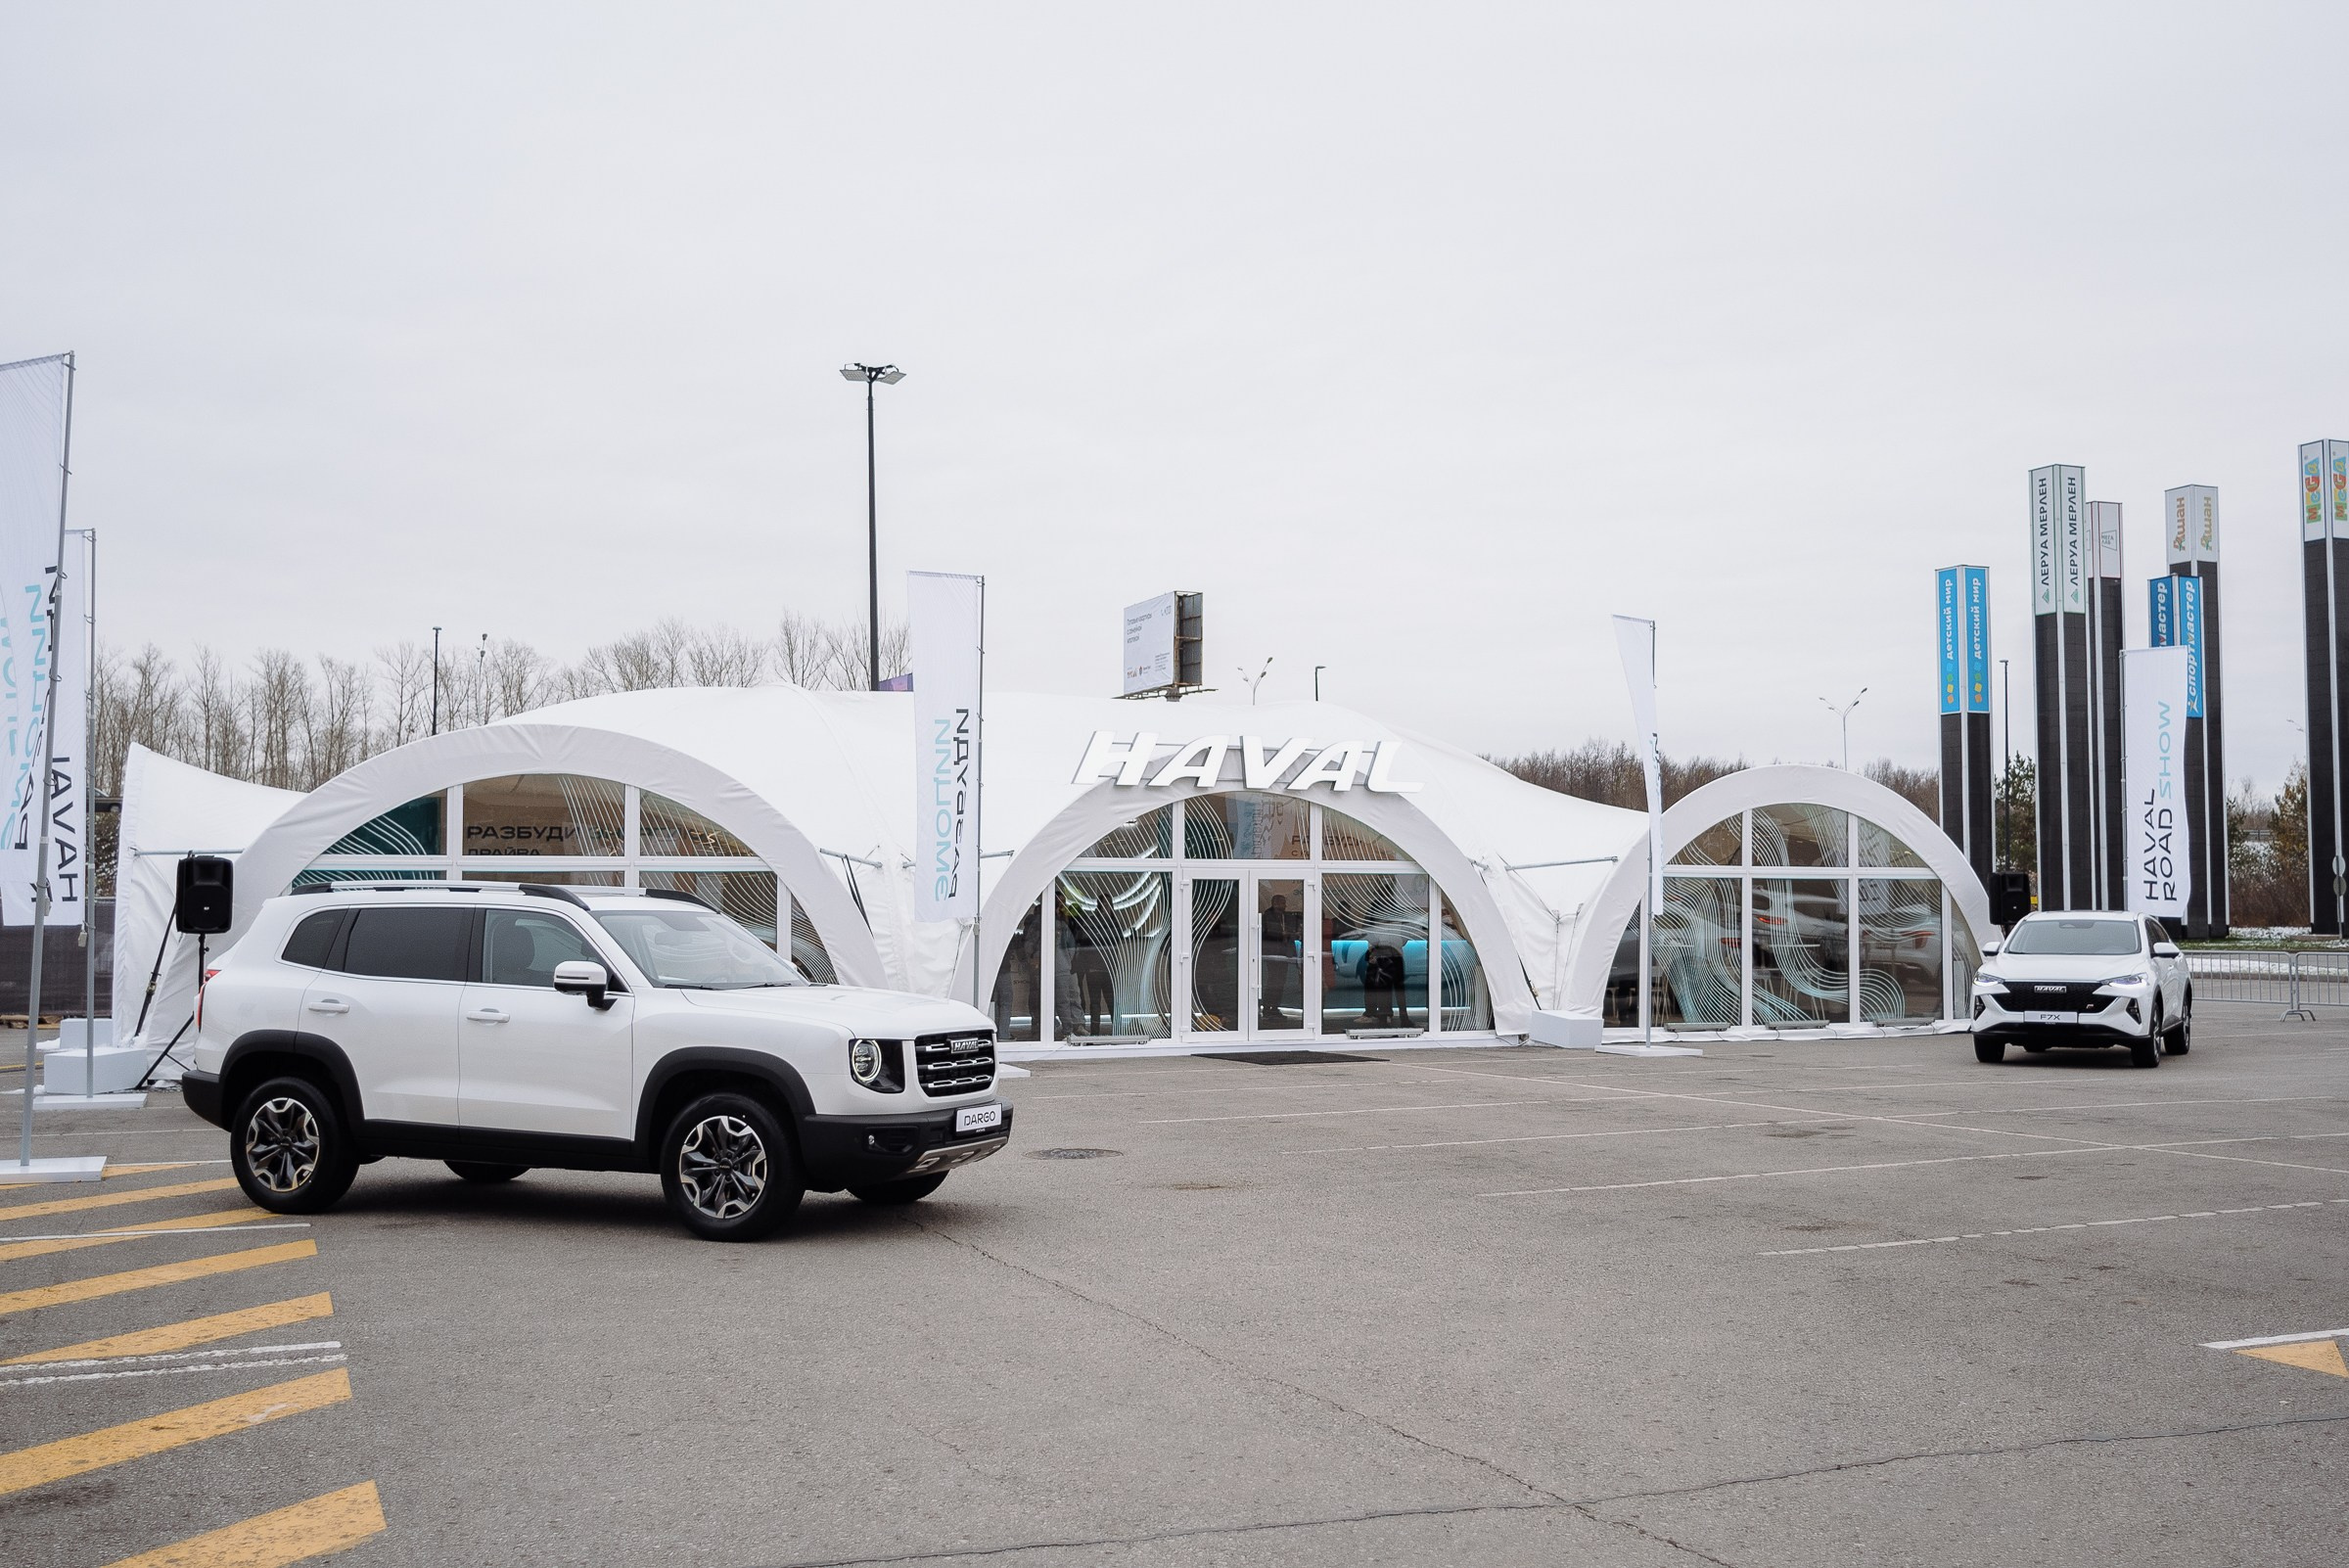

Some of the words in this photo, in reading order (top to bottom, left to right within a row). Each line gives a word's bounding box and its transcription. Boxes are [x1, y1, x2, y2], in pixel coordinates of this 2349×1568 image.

[2039, 477, 2049, 536] МЕРЛЕН
[2067, 477, 2078, 535] МЕРЛЕН
[2040, 539, 2050, 586] ЛЕРУА
[2069, 539, 2079, 586] ЛЕРУА
[2157, 581, 2168, 646] мастер
[1072, 730, 1425, 793] HAVAL
[2158, 701, 2172, 800] SHOW
[2143, 788, 2159, 901] HAVAL
[2158, 807, 2178, 901] ROAD
[953, 1039, 979, 1052] HAVAL
[963, 1110, 996, 1127] DARGO
